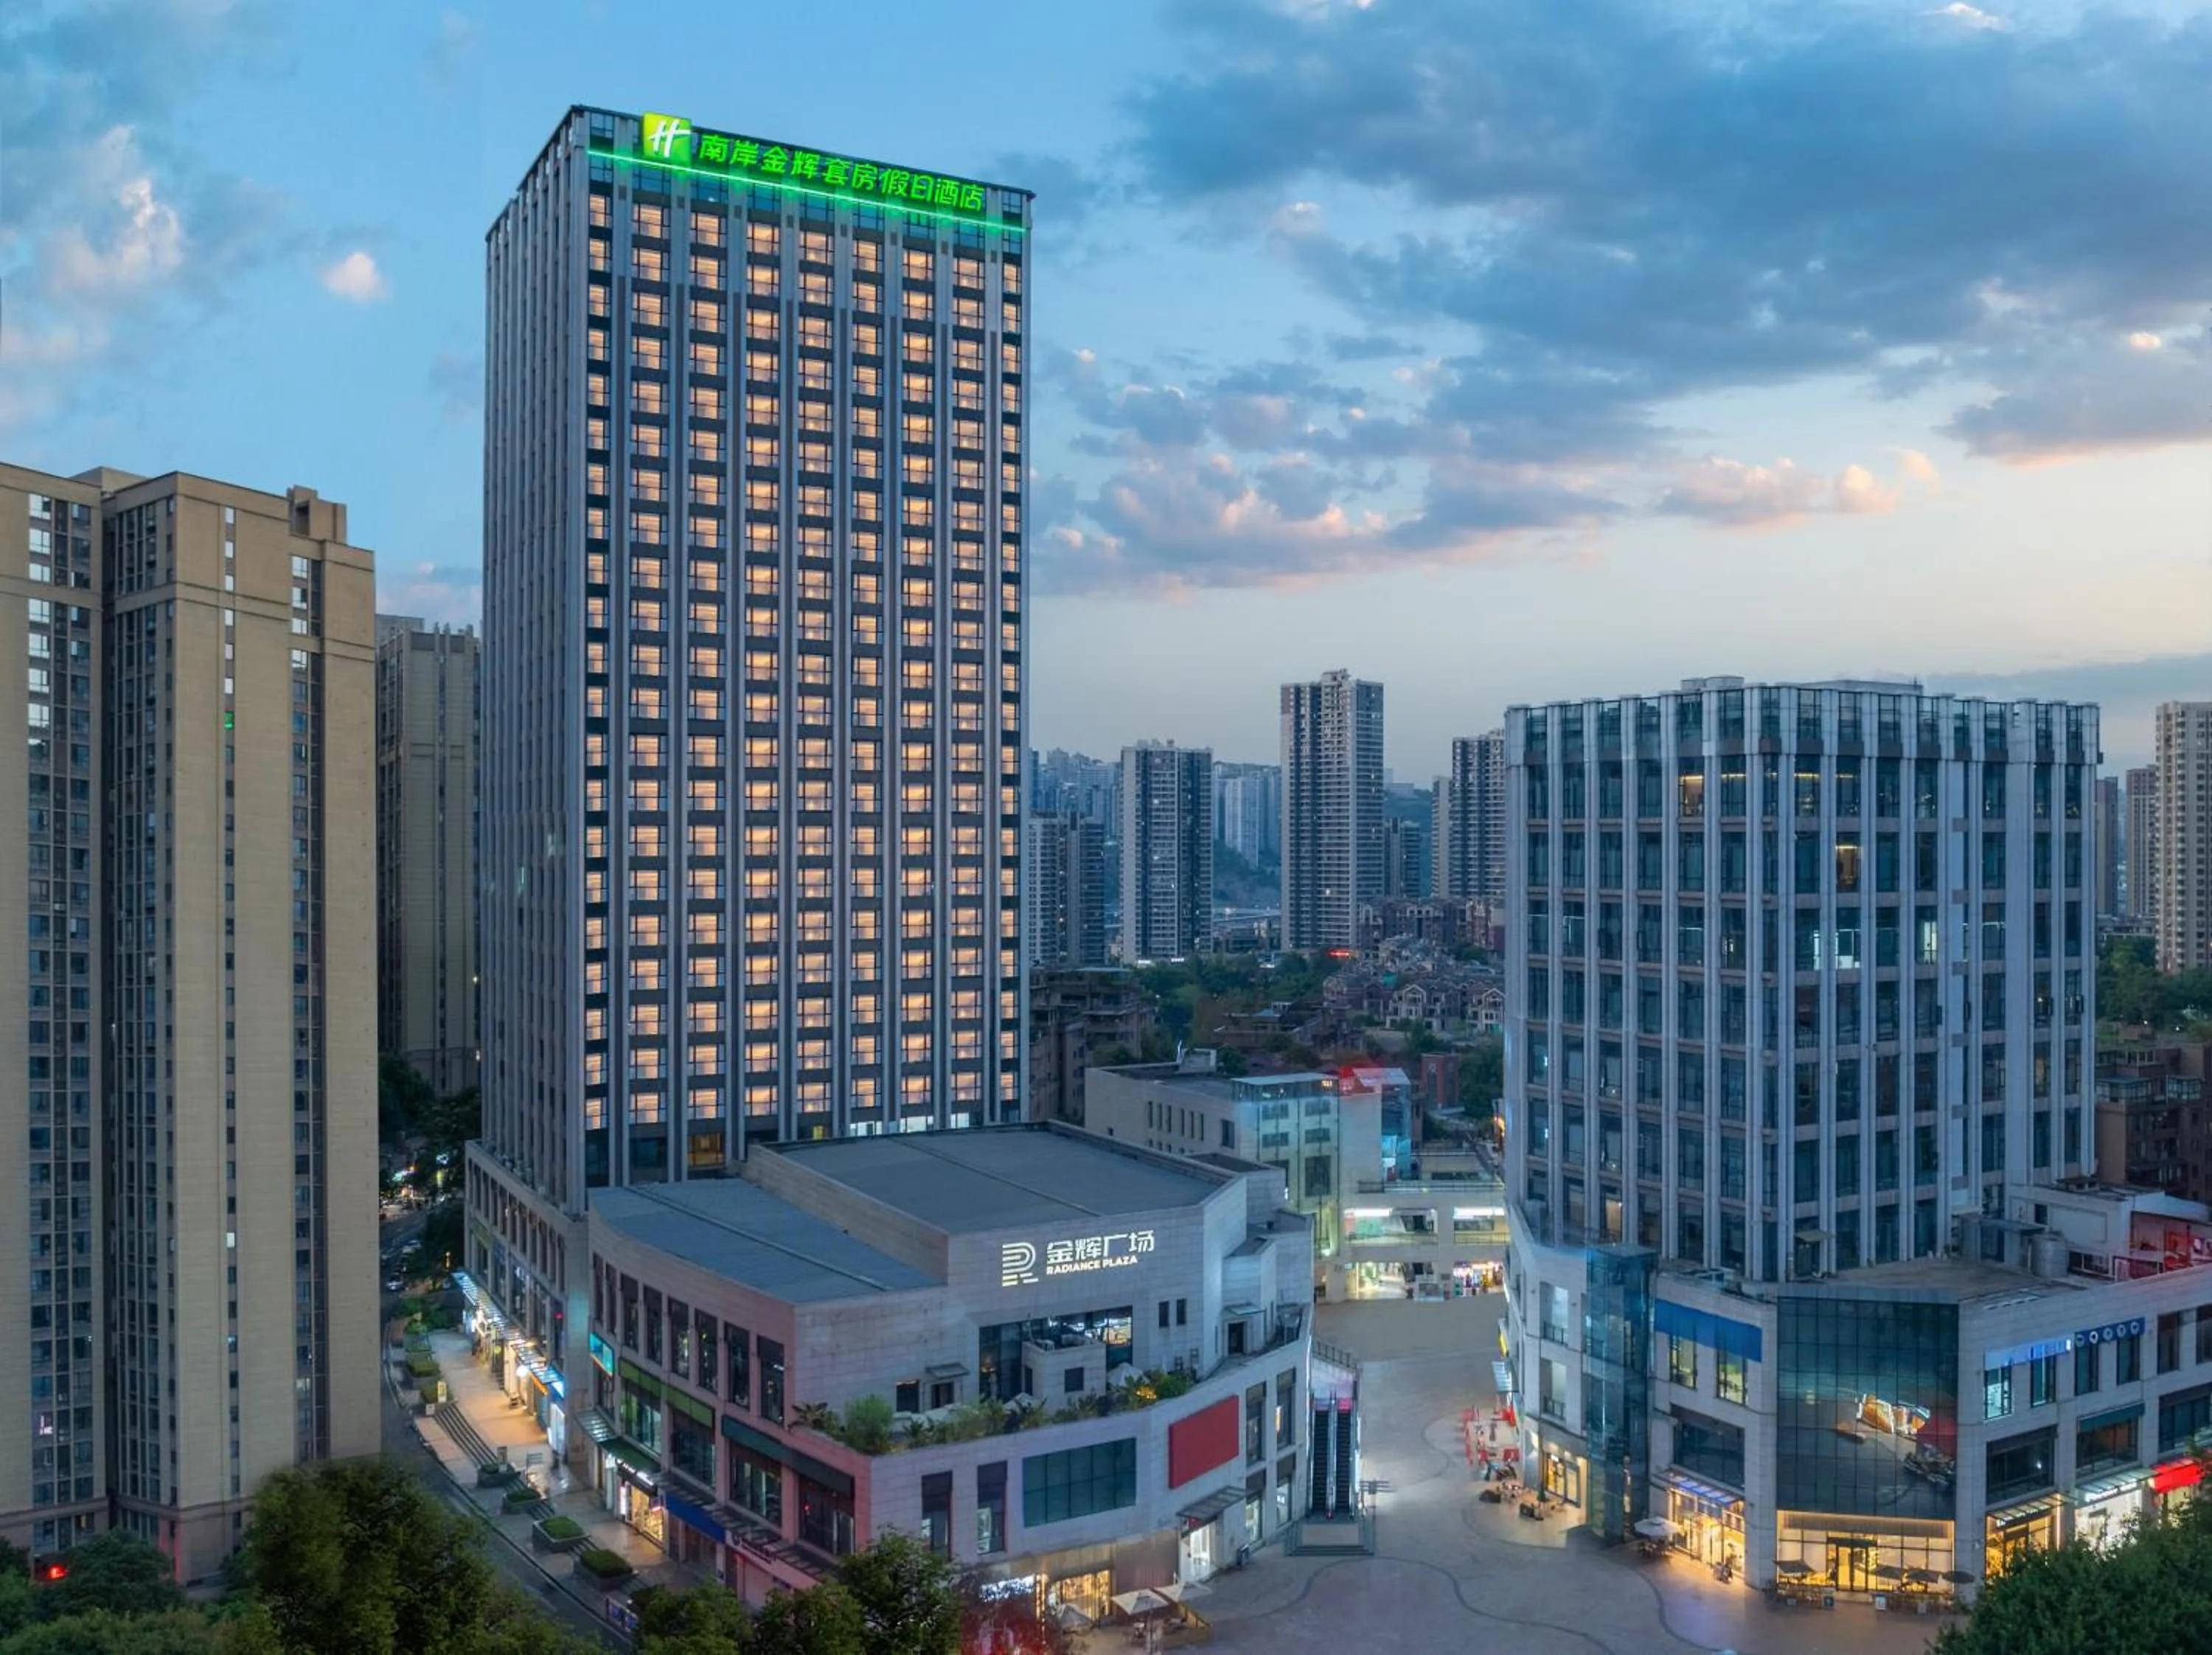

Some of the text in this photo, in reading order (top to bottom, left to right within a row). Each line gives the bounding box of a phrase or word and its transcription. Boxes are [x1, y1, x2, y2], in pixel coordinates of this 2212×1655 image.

[698, 133, 985, 212] 南岸金辉套房假日酒店
[1046, 1229, 1154, 1264] 金辉广场
[1046, 1255, 1138, 1275] RADIANCE PLAZA
